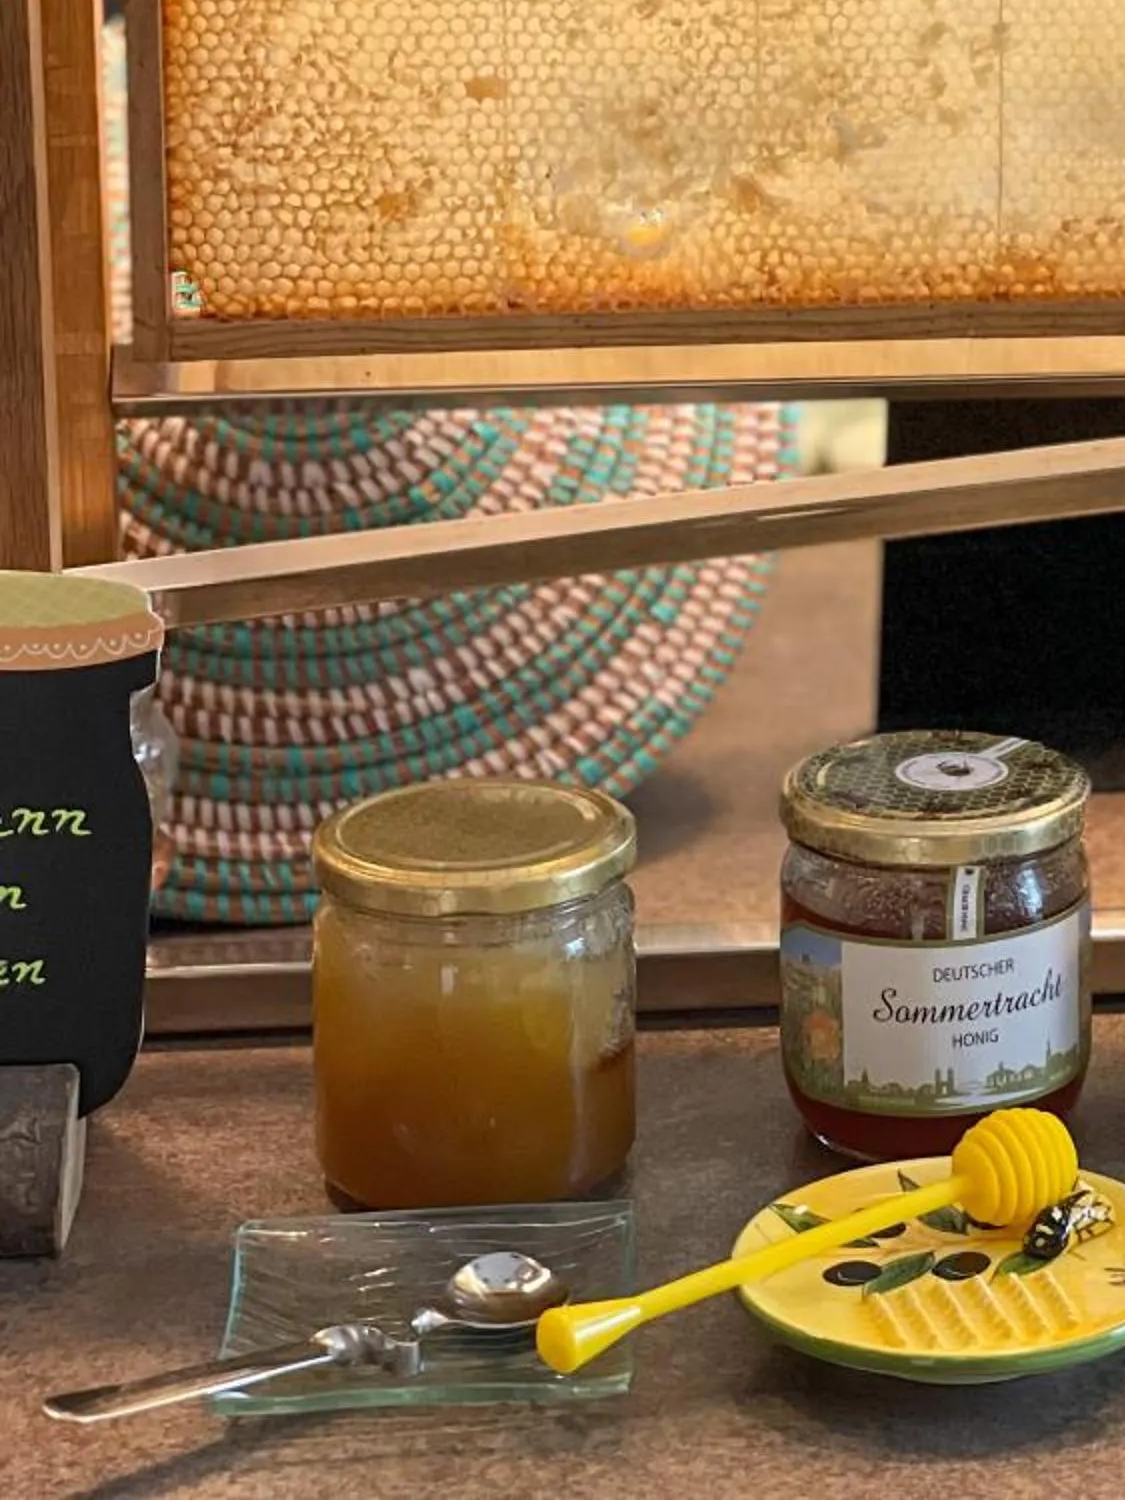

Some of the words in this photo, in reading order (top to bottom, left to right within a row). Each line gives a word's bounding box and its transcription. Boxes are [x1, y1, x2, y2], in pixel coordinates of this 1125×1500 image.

[933, 958, 1015, 983] DEUTSCHER
[873, 967, 1063, 1024] Sommertracht
[952, 1029, 999, 1048] HONIG
